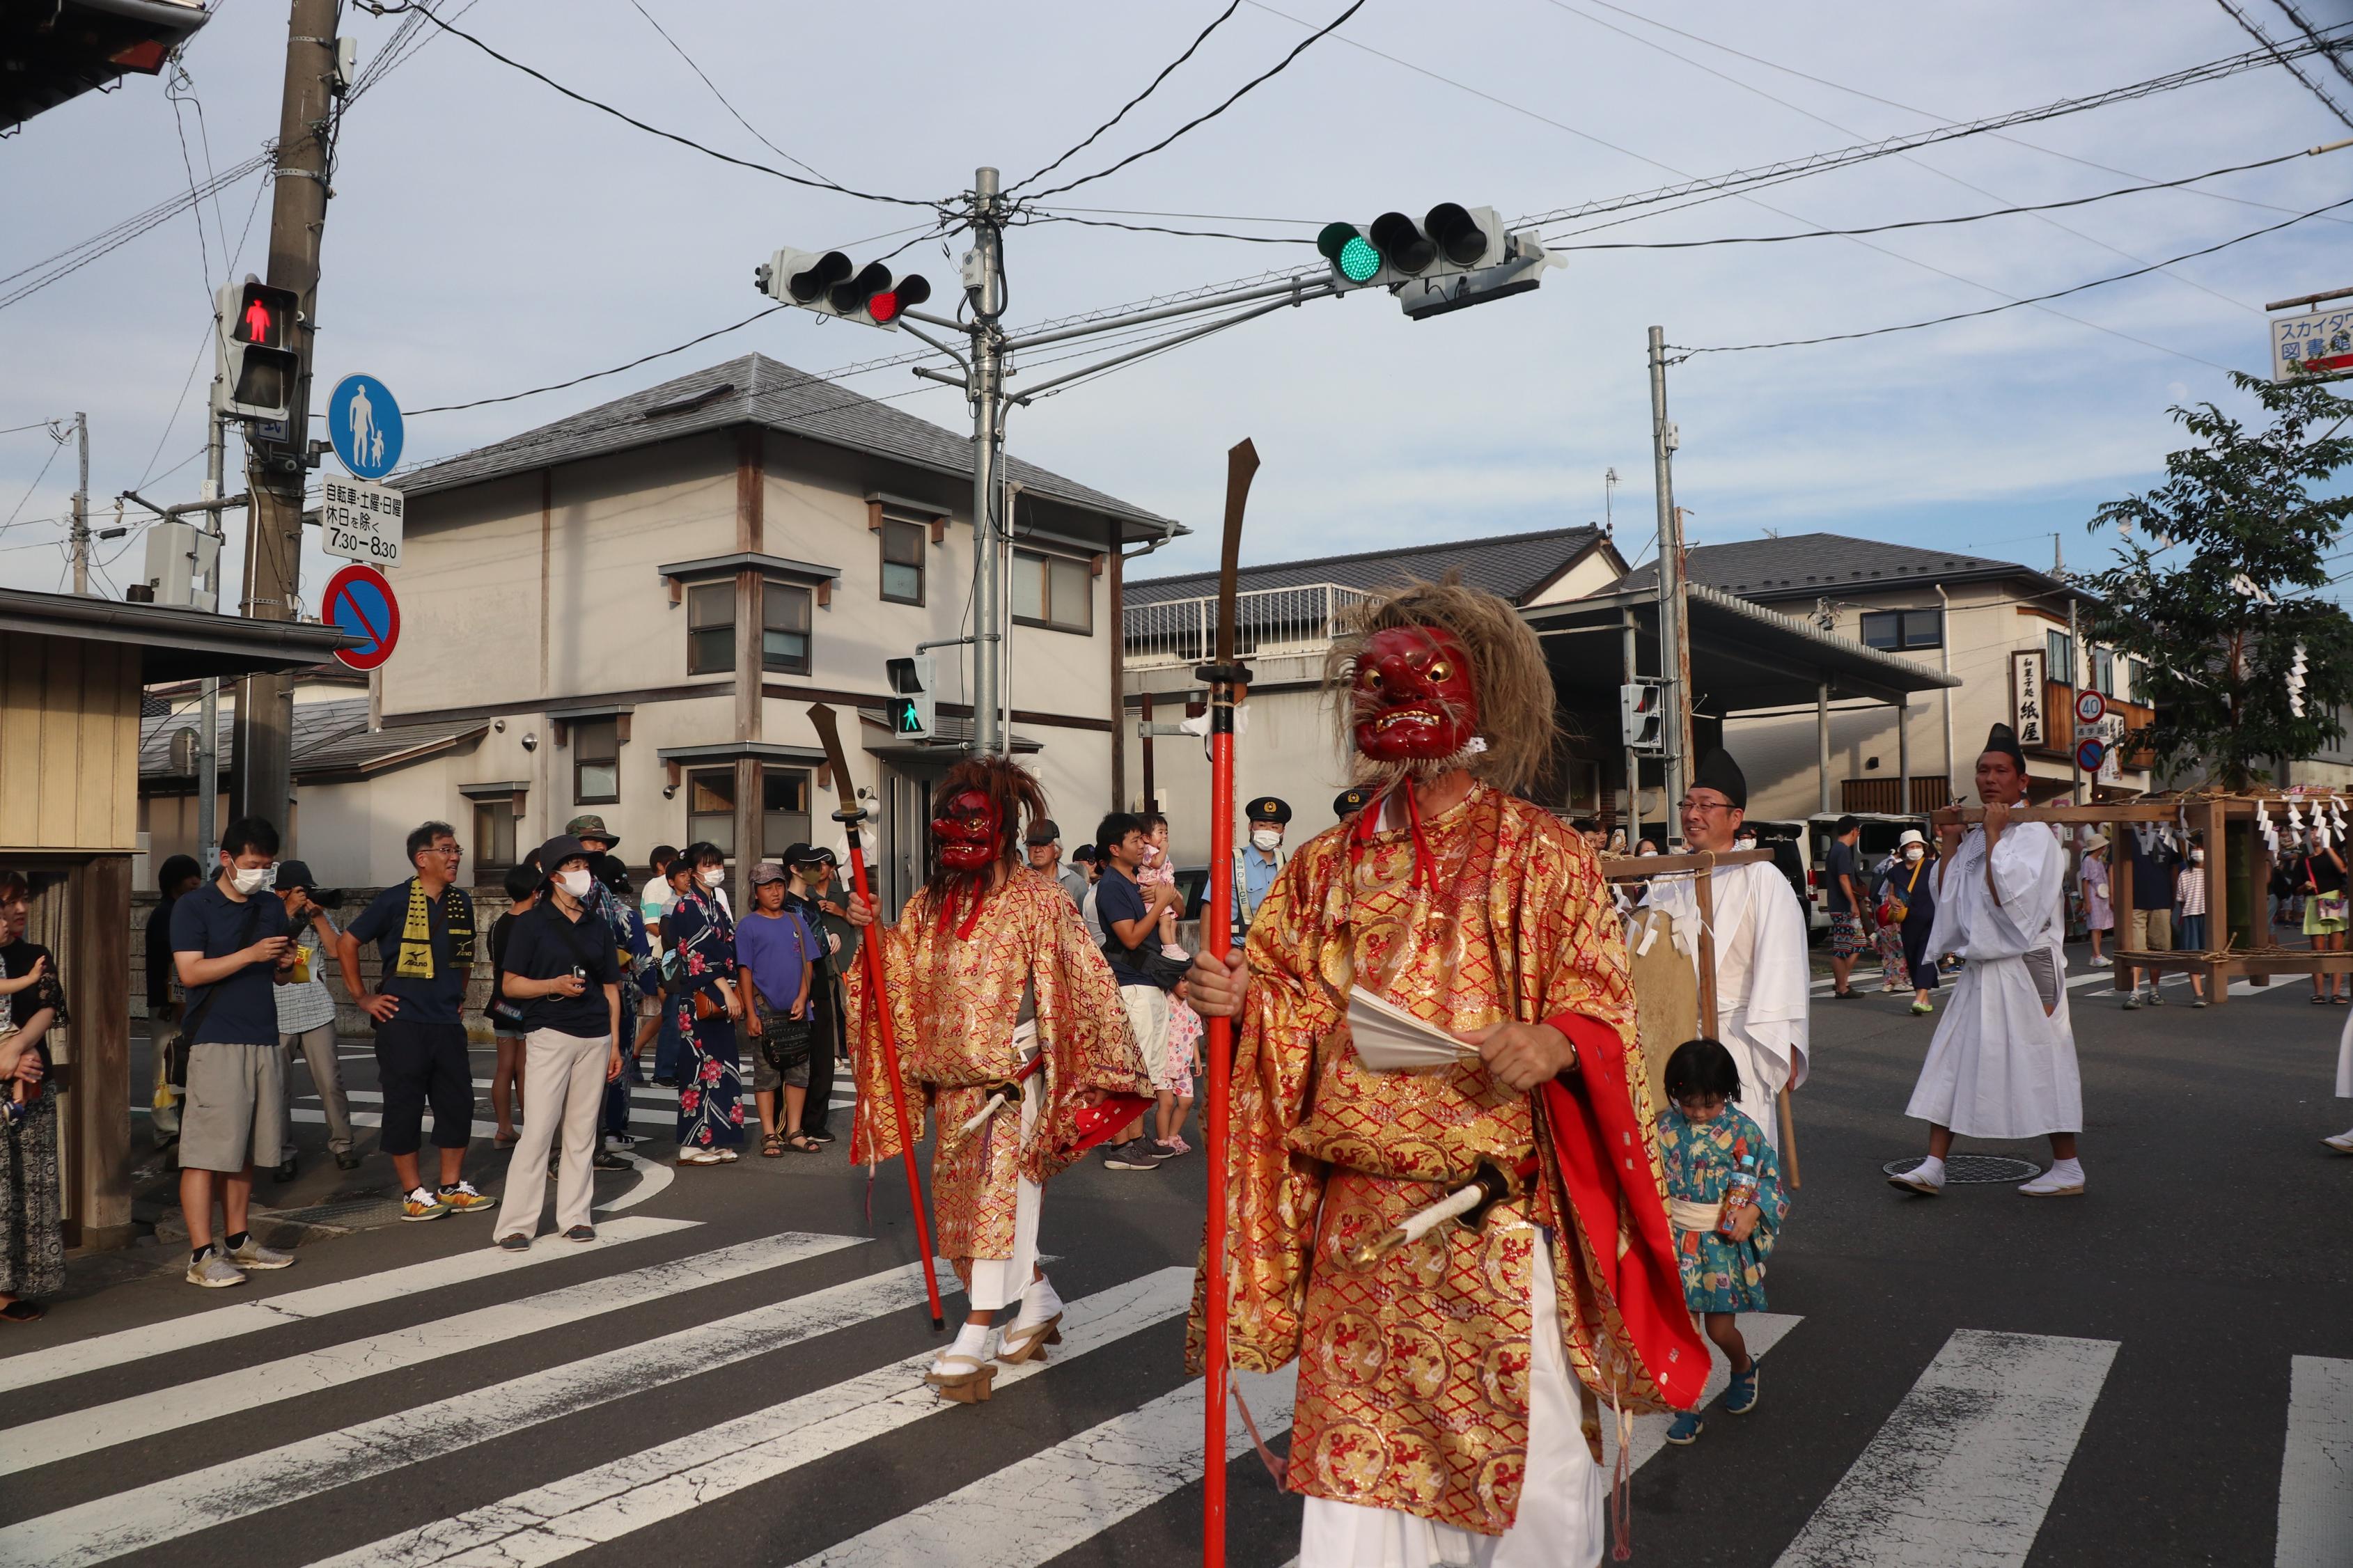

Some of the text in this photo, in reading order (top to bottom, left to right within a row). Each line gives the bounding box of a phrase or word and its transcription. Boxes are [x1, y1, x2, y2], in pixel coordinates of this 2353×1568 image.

[327, 482, 402, 517] 自転車・土曜・日曜
[326, 504, 380, 533] 休日を除く
[2019, 657, 2040, 742] 和菓子処 紙屋
[2082, 698, 2099, 714] 40
[1237, 865, 1248, 905] POLICE
